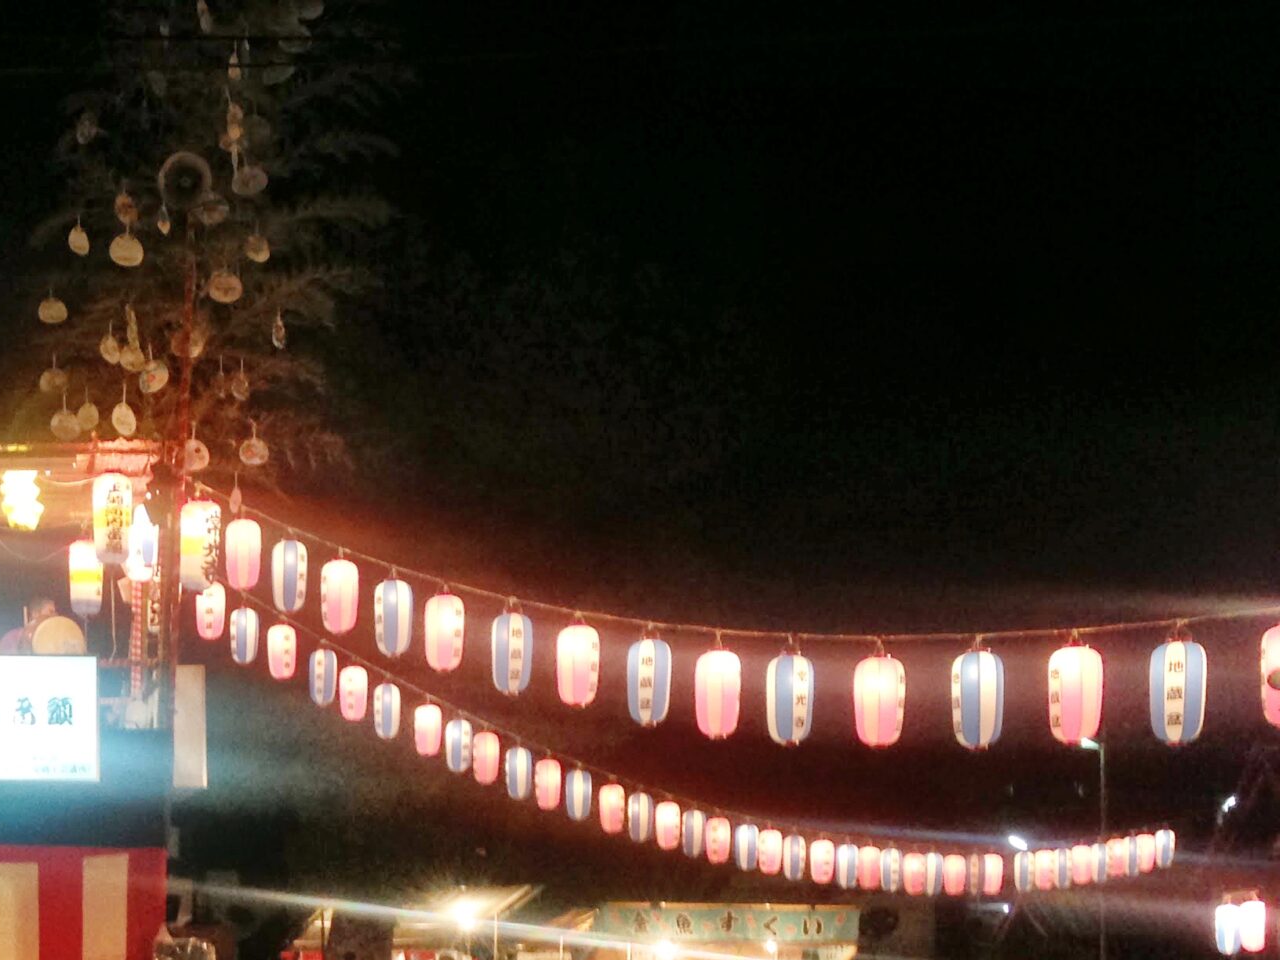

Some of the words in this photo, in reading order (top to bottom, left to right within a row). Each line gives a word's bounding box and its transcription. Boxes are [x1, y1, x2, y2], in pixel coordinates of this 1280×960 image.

[1167, 661, 1183, 727] 地蔵盆
[634, 910, 823, 937] 金魚すくい
